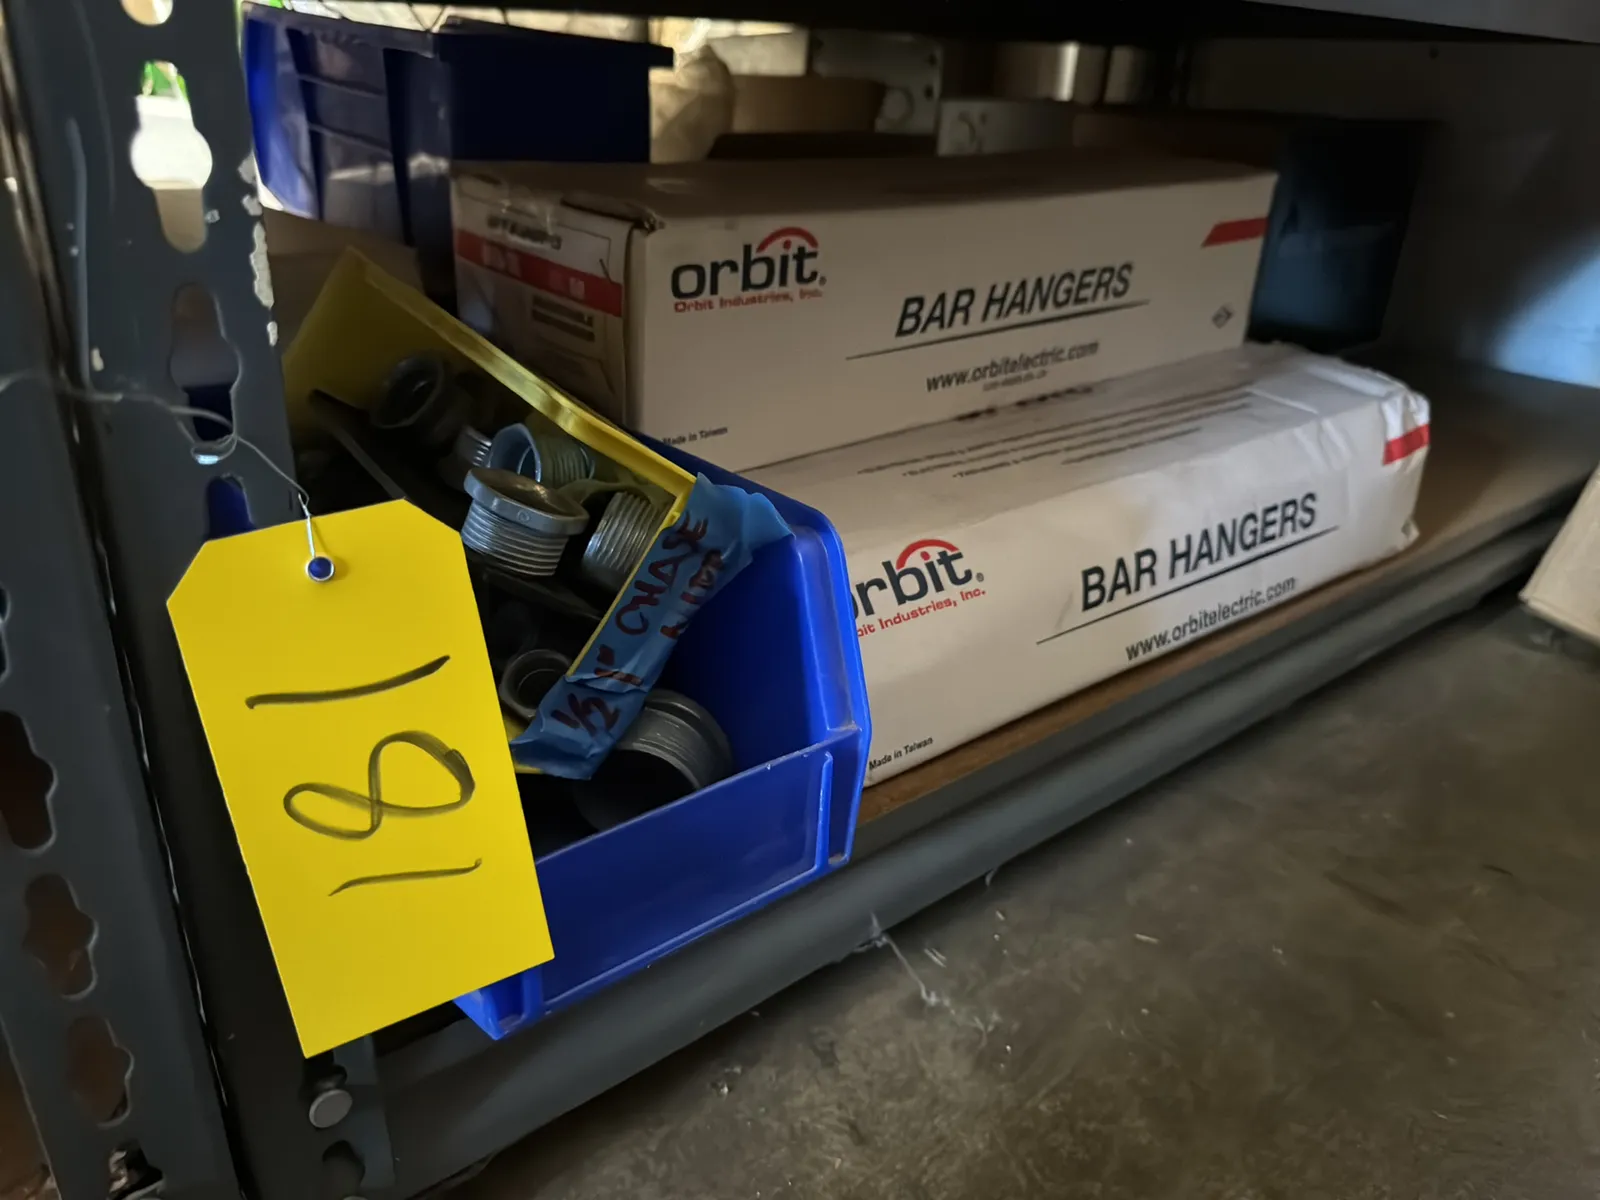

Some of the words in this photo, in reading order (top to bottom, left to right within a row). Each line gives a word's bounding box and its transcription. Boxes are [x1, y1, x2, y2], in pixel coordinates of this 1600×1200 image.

[671, 237, 819, 299] orbit
[895, 287, 974, 338] BAR
[981, 261, 1134, 323] HANGERS
[674, 299, 714, 313] Orbit
[926, 341, 1099, 393] www.orbitelectric.com
[615, 510, 708, 636] CHASE
[1081, 547, 1158, 613] BAR
[1169, 492, 1317, 581] HANGERS
[877, 598, 958, 630] Industries,
[960, 588, 986, 602] Inc.
[1125, 576, 1296, 662] www.orbitelectric.com
[245, 654, 483, 896] 181
[868, 753, 892, 770] Made
[894, 749, 903, 758] in
[903, 737, 933, 754] Taiwan
